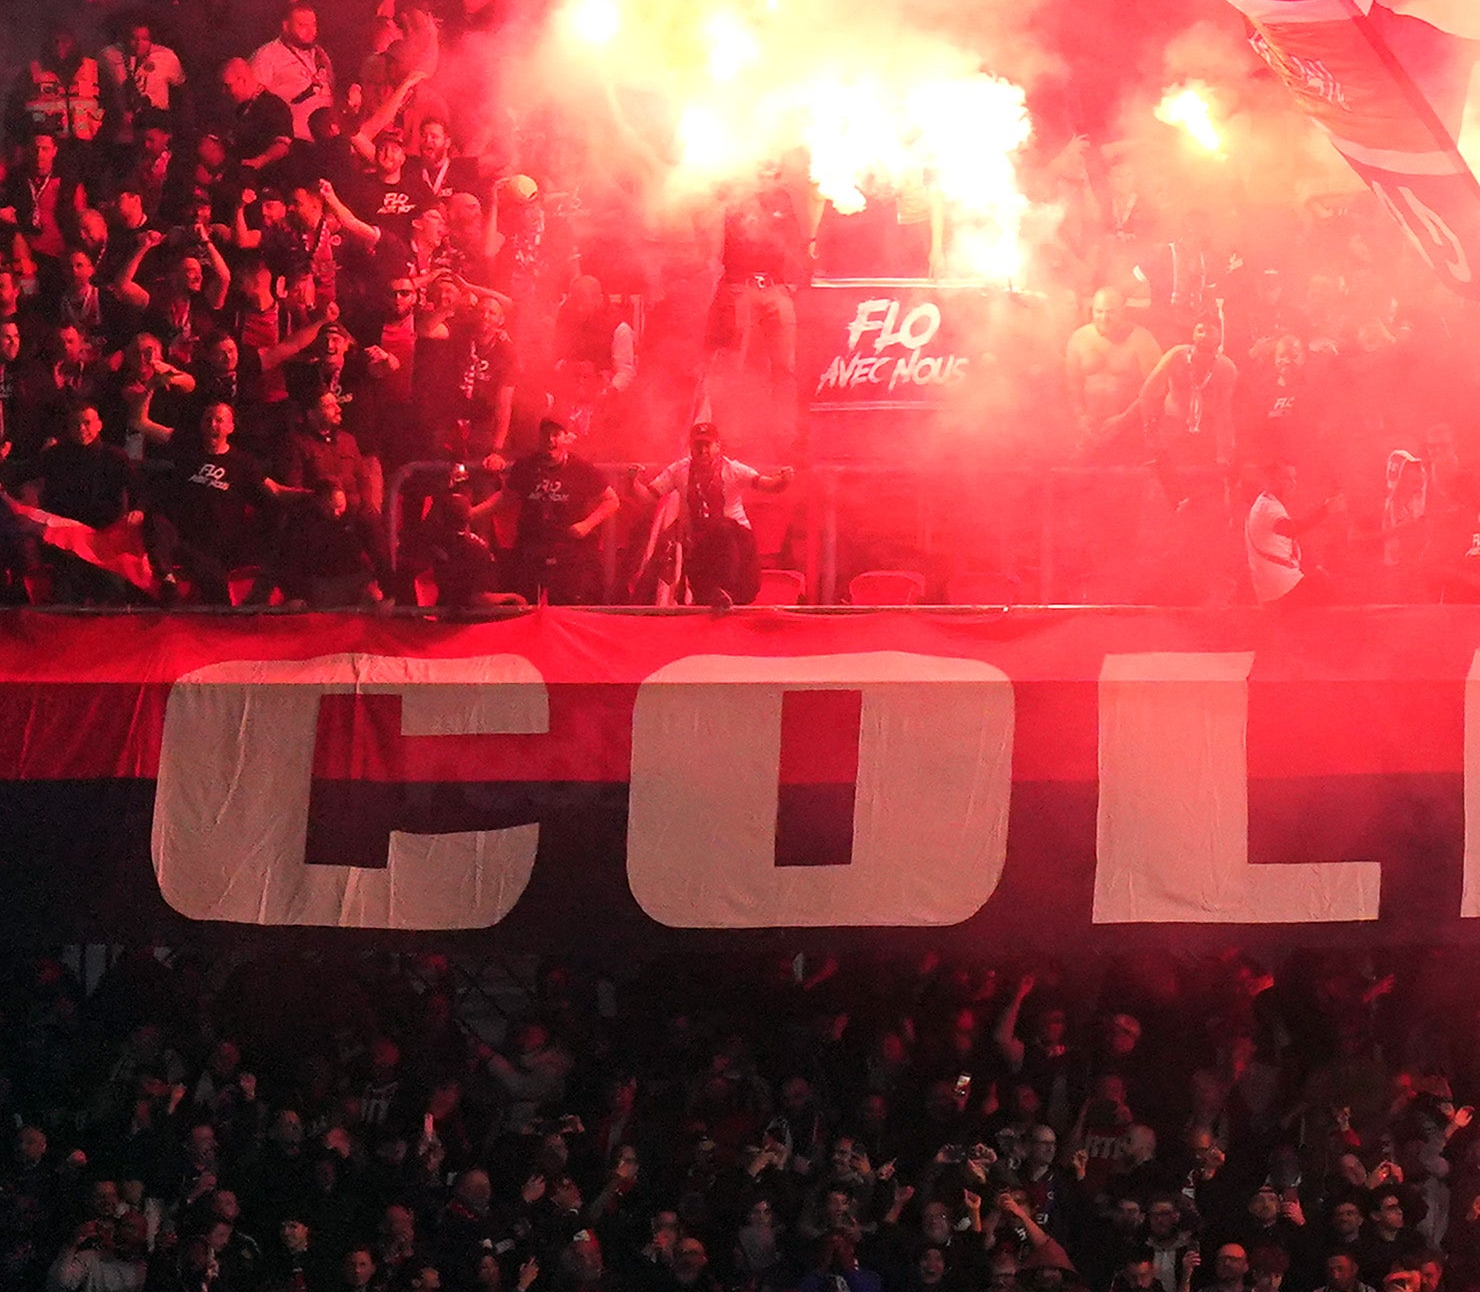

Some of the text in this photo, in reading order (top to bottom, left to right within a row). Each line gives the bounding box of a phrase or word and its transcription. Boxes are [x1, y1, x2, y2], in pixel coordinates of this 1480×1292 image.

[846, 297, 941, 355] FLO
[814, 346, 969, 396] AVEC NOUS
